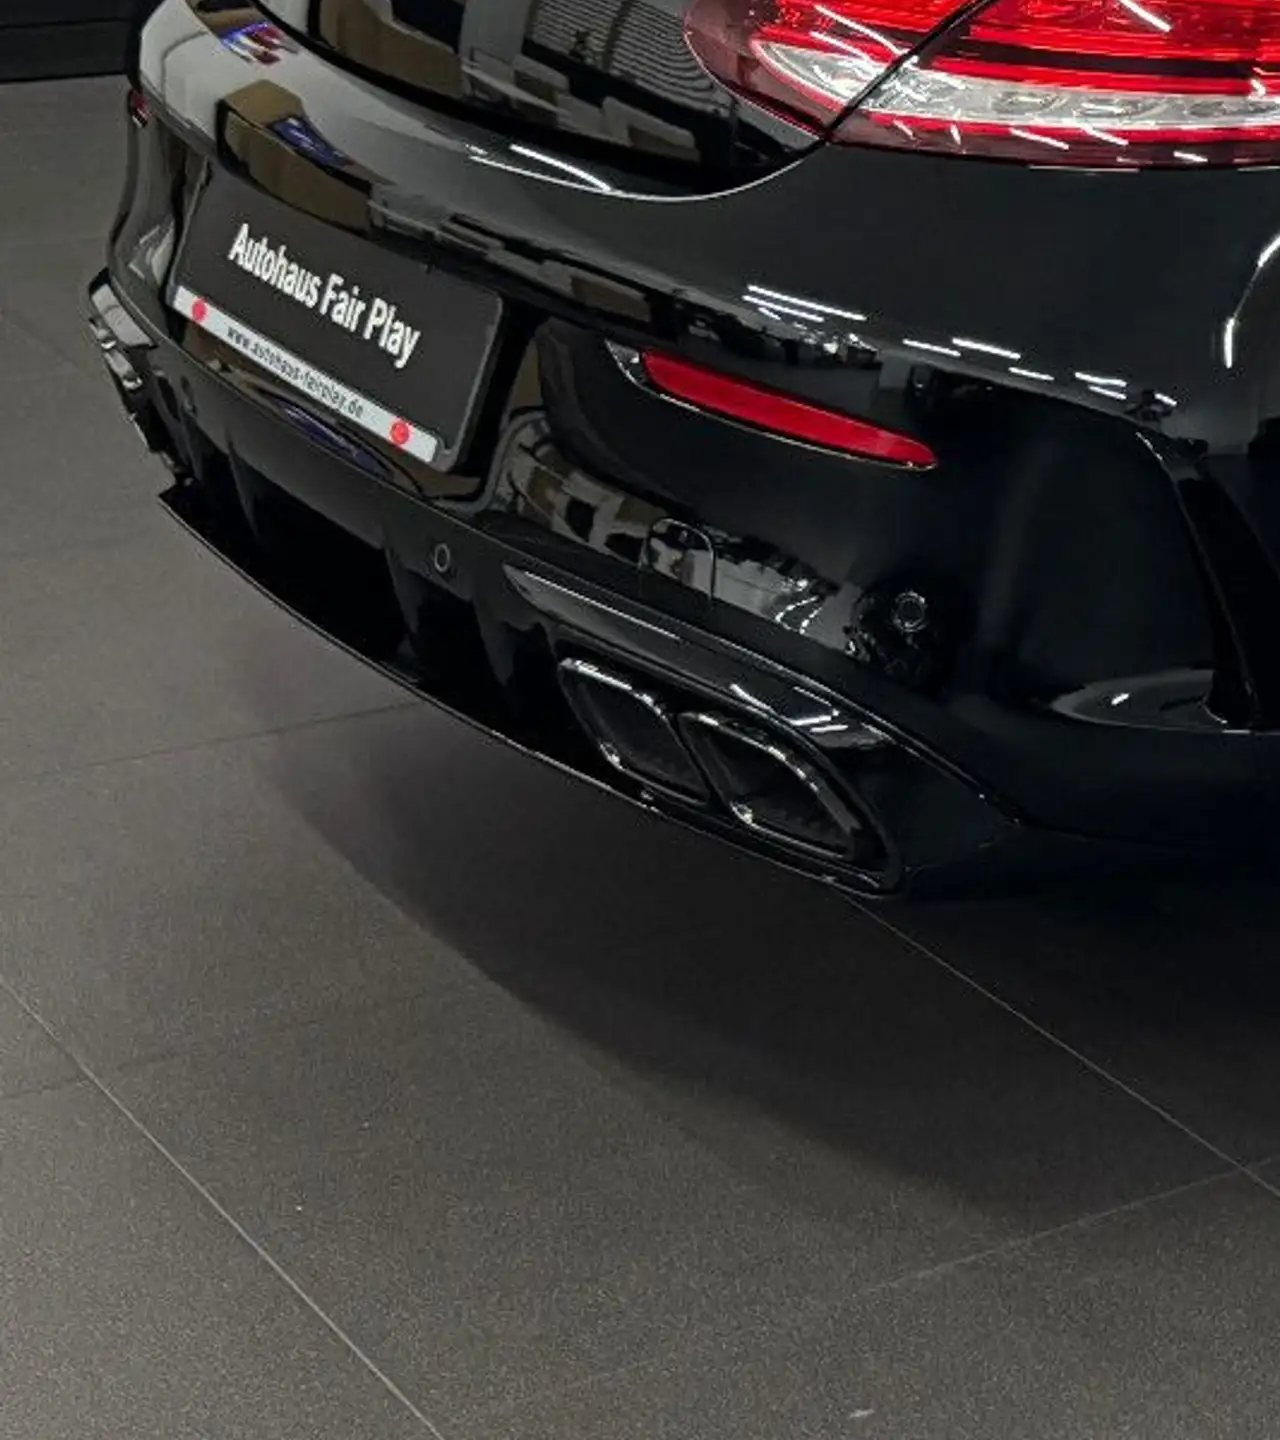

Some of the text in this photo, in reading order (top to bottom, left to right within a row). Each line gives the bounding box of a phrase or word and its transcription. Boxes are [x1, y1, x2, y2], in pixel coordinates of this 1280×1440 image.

[228, 223, 421, 369] Autohaus Fair Play
